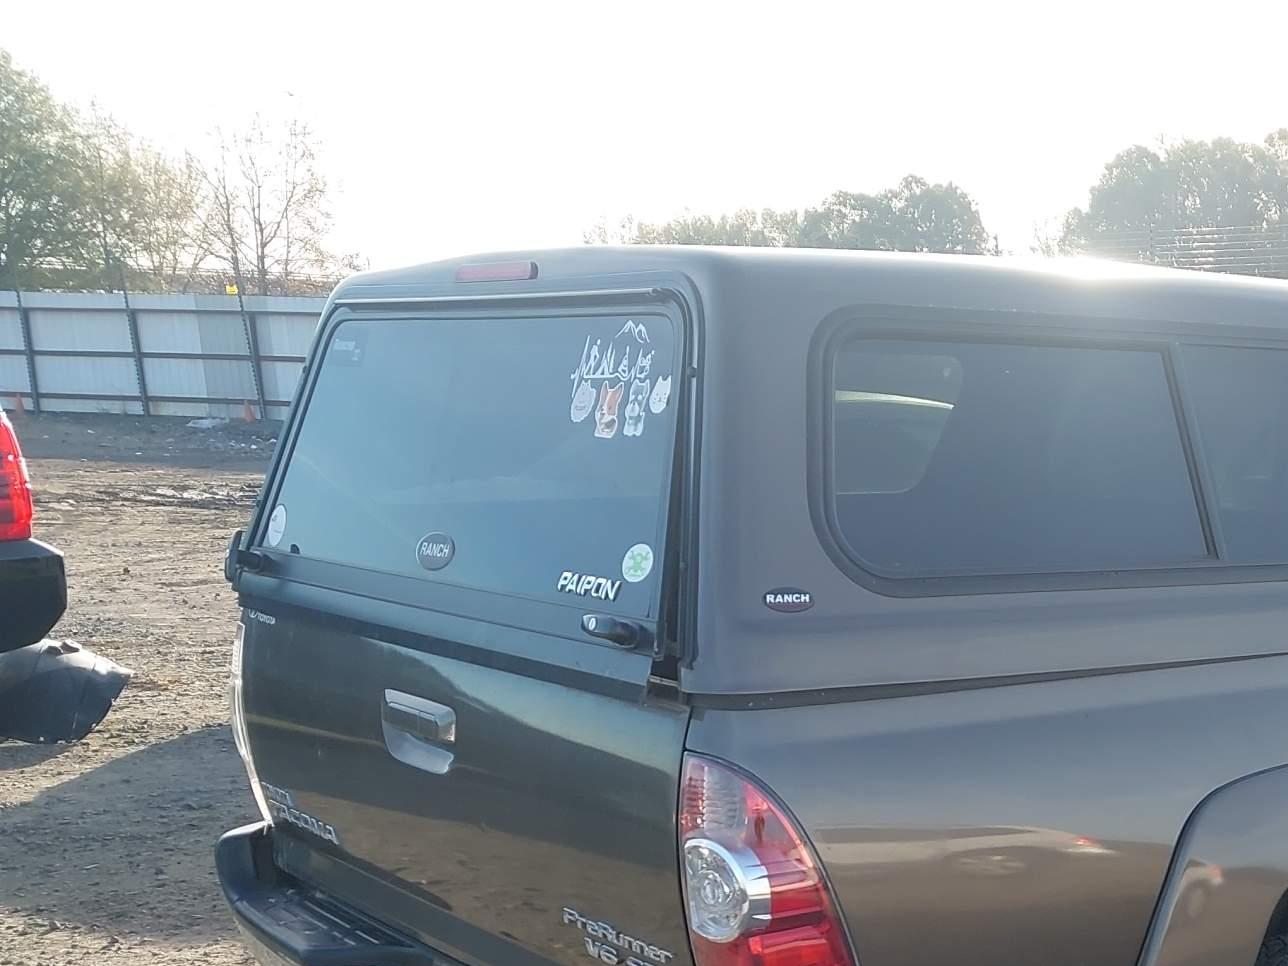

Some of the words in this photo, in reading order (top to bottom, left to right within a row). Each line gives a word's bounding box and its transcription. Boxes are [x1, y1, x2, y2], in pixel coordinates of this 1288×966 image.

[420, 541, 450, 558] RANCH
[766, 593, 810, 604] RANCH
[562, 907, 673, 964] PreRunner
[584, 936, 619, 966] V6
